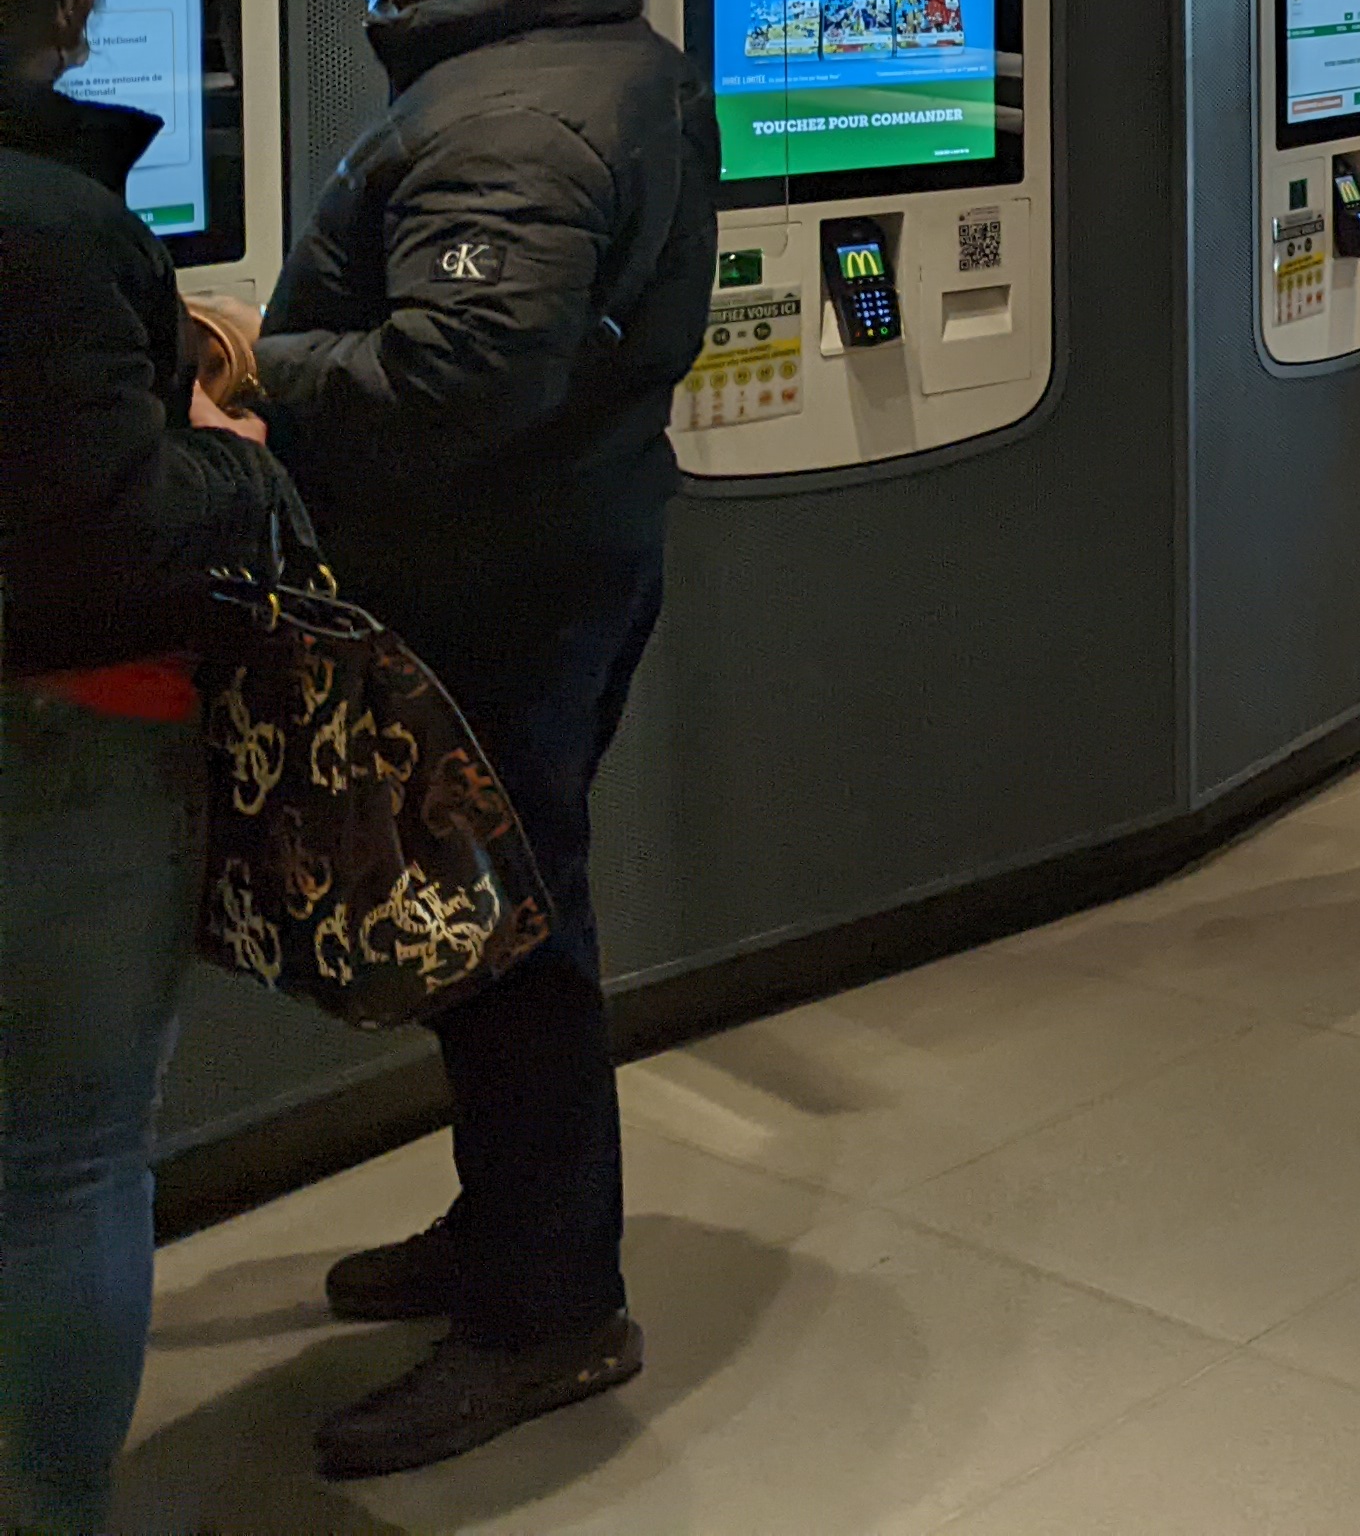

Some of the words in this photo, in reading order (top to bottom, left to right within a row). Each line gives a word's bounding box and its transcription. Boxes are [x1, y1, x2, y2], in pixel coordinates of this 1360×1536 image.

[103, 35, 147, 46] McDonald
[93, 76, 110, 84] être
[112, 74, 149, 84] entourés
[152, 74, 162, 82] de
[752, 118, 826, 135] TOUCHEZ
[829, 115, 868, 129] POUR
[871, 109, 963, 127] COMMANDER
[748, 304, 779, 319] VOUS
[780, 302, 796, 314] ICI
